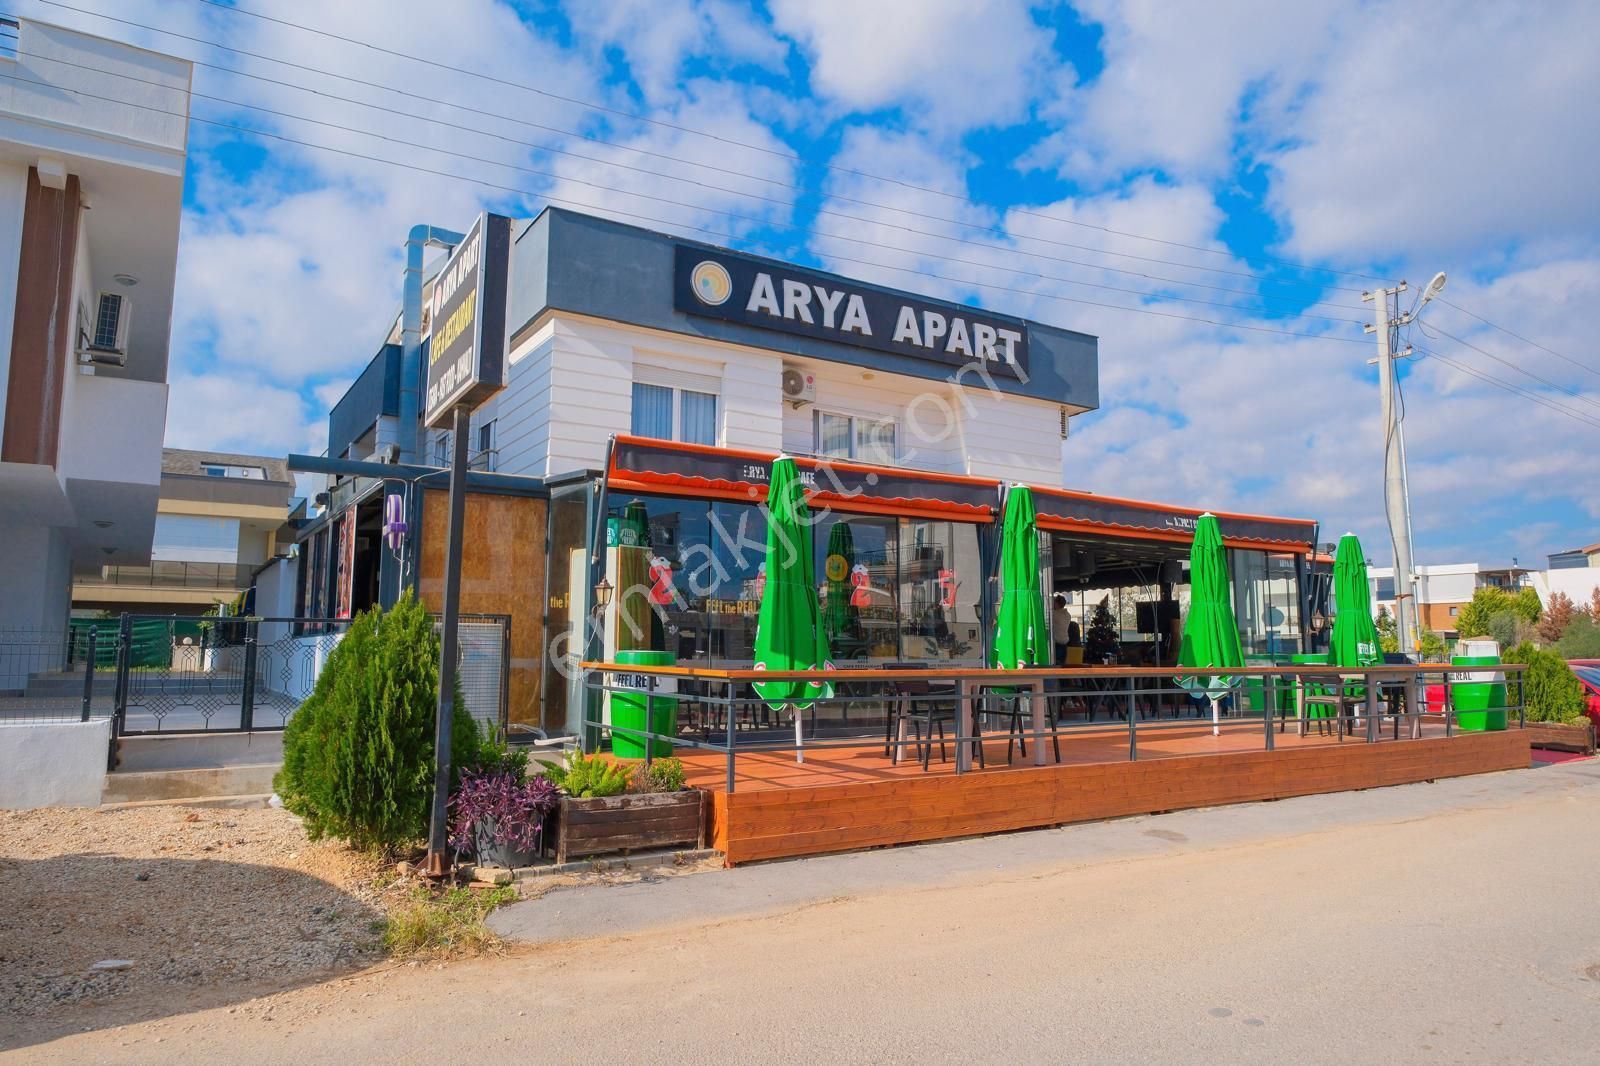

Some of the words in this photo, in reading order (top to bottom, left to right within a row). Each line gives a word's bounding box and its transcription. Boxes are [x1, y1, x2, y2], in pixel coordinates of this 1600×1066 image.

[746, 272, 873, 336] ARYA
[891, 305, 1022, 365] APART
[551, 595, 564, 609] the
[725, 603, 736, 614] the
[635, 674, 660, 688] REL
[1456, 671, 1472, 681] REAL
